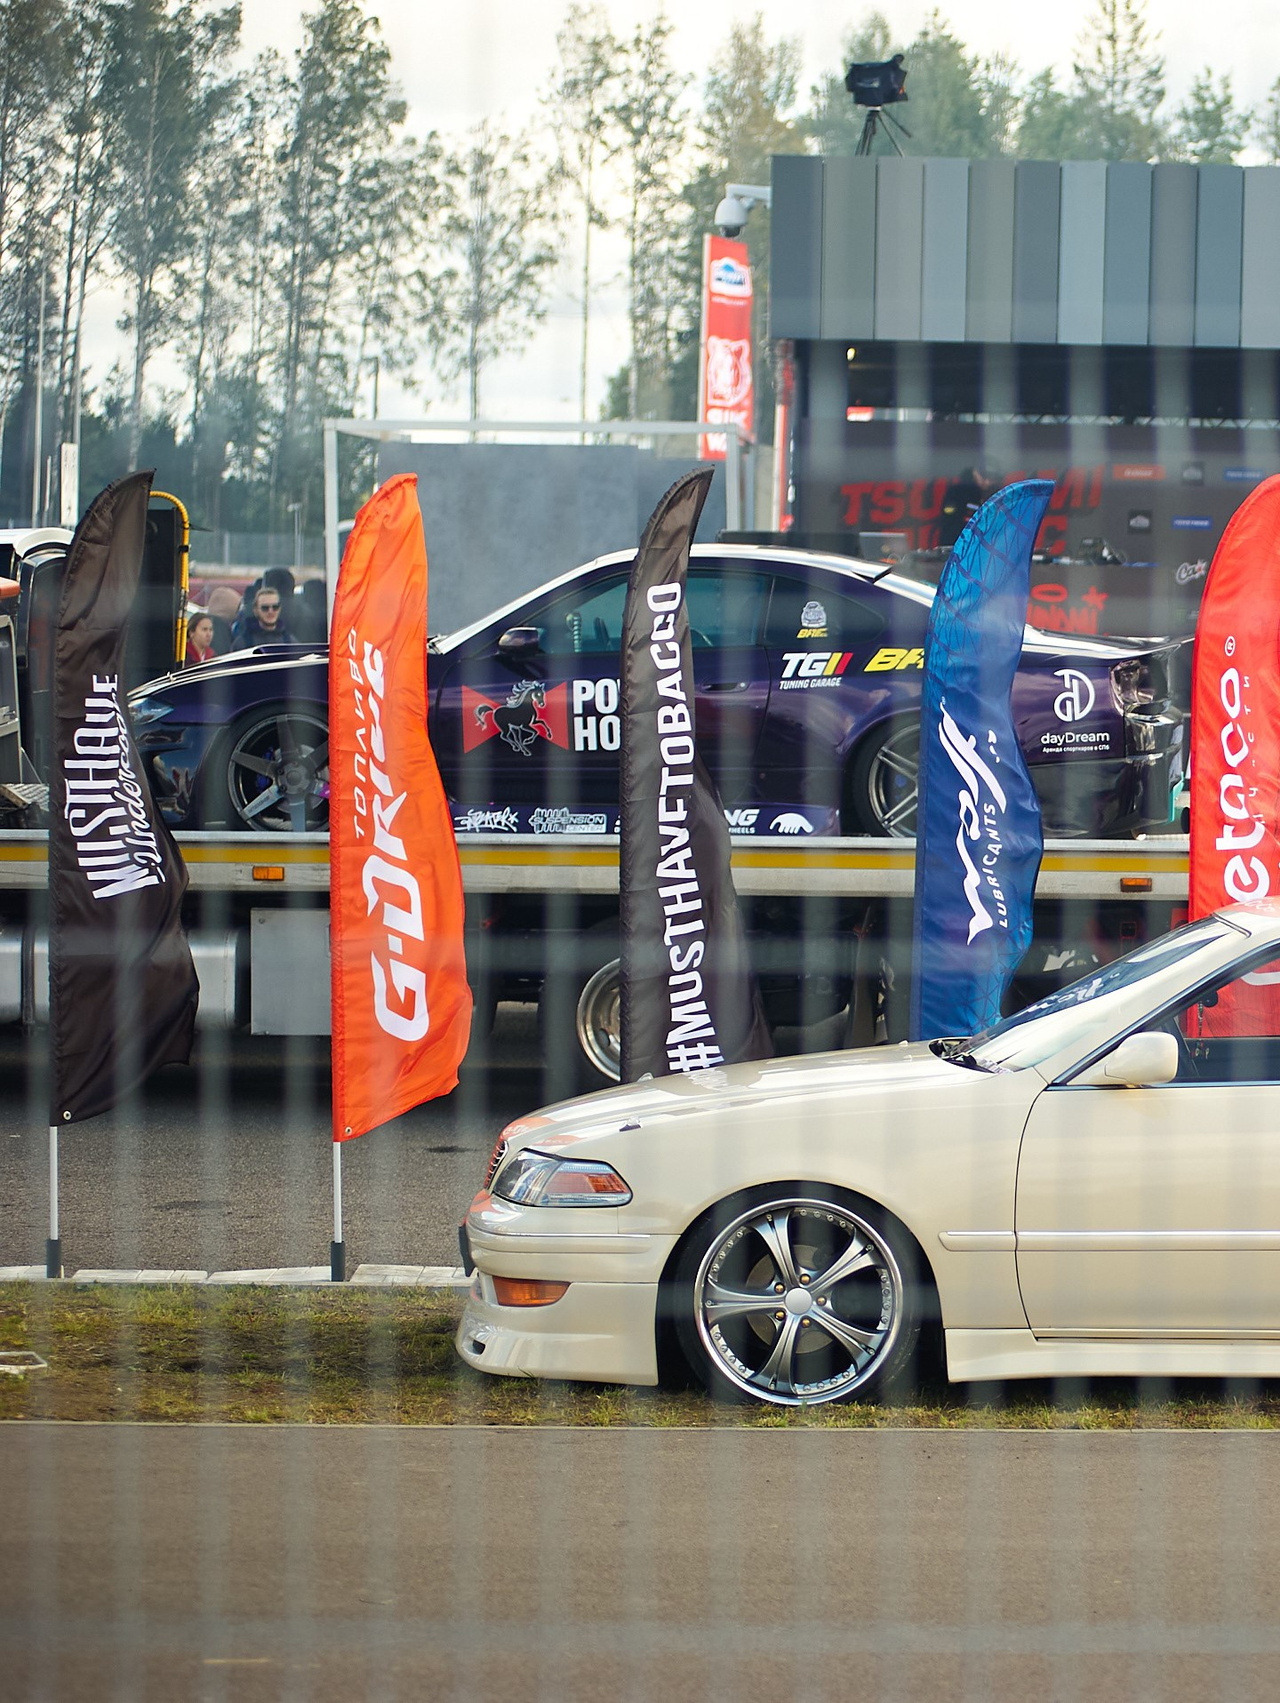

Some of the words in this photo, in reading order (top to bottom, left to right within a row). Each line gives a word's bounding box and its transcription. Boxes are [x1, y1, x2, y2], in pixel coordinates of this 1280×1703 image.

[348, 627, 368, 839] ТОПЛИВО
[779, 680, 810, 690] TUNING
[810, 677, 842, 688] GARAGE
[1040, 732, 1110, 746] dayDream
[646, 582, 724, 1072] #MUSTHAVETOBACCO
[981, 802, 1009, 929] LUBRICANTS
